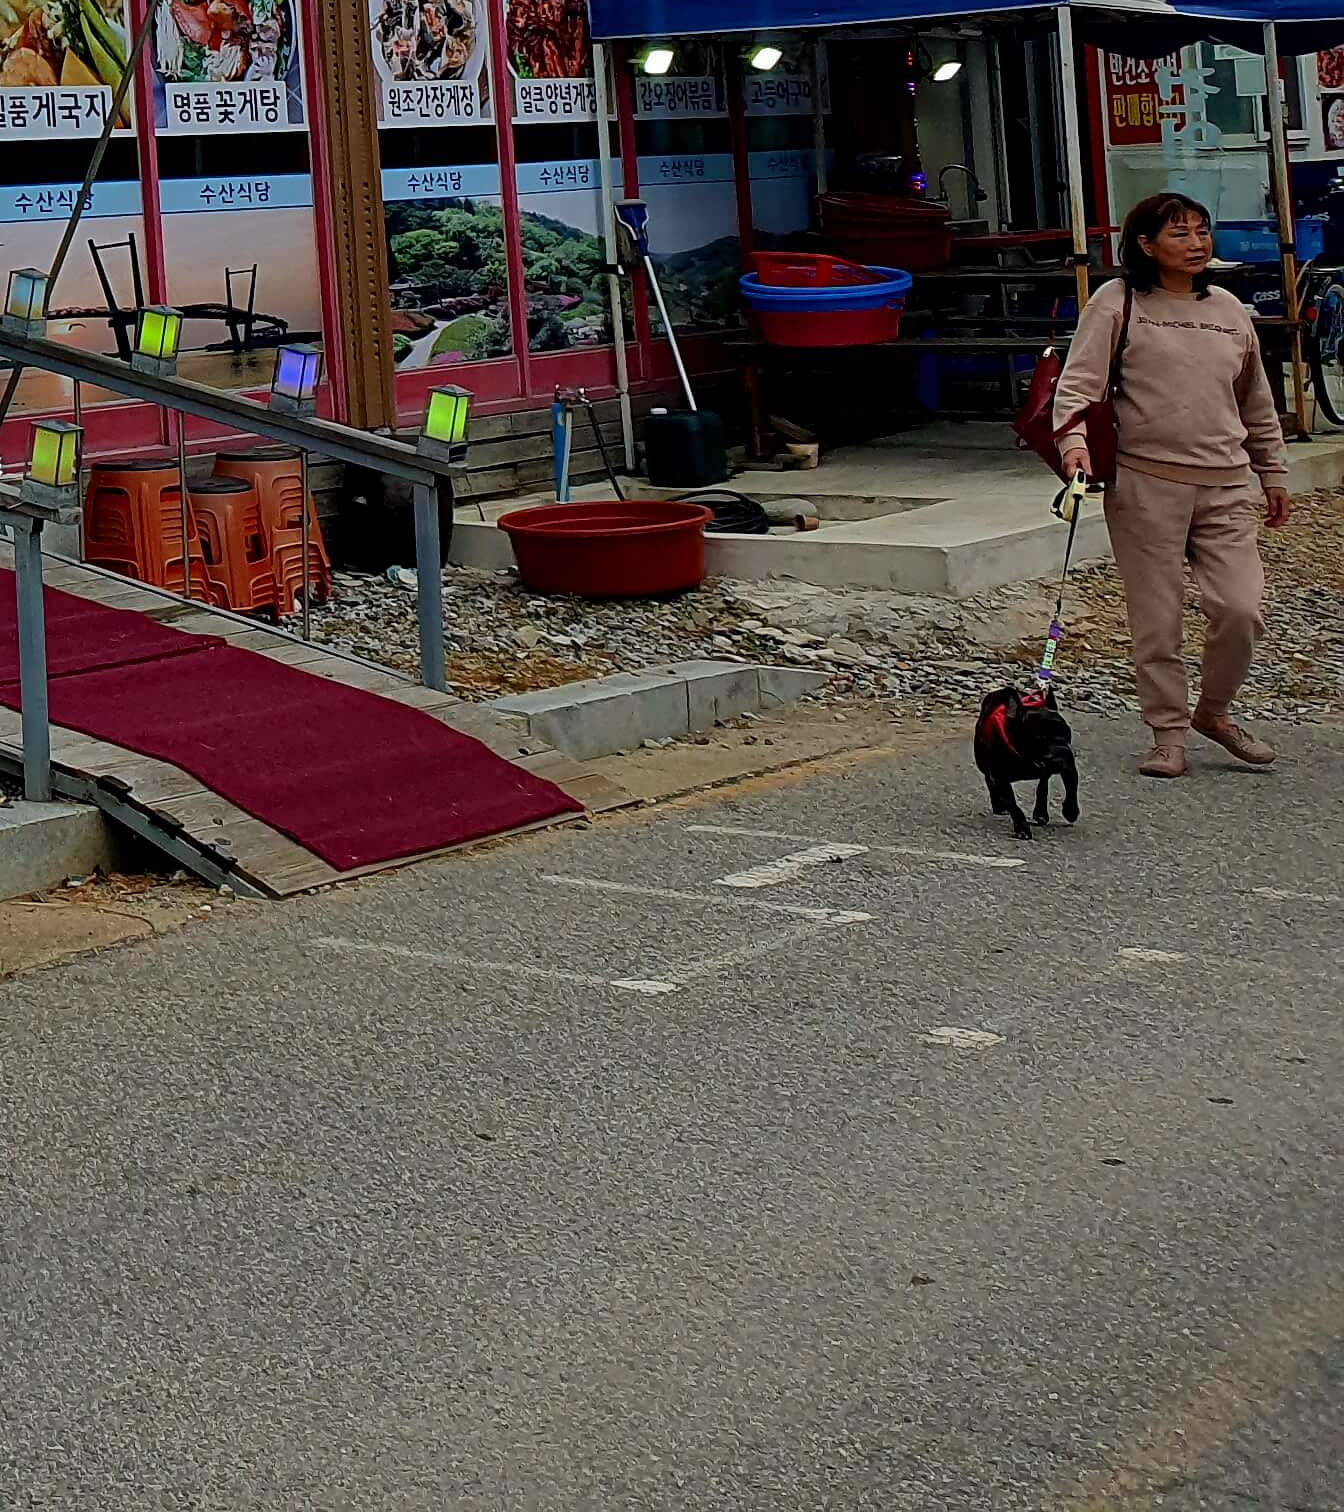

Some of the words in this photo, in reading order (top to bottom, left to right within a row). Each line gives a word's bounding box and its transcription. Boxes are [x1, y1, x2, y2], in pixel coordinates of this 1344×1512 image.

[173, 88, 280, 125] 명품꽃게탕
[388, 83, 474, 118] 원조간장게장
[407, 172, 463, 193] 수산식당
[539, 165, 591, 186] 수산식당
[199, 181, 271, 204] 수산식당
